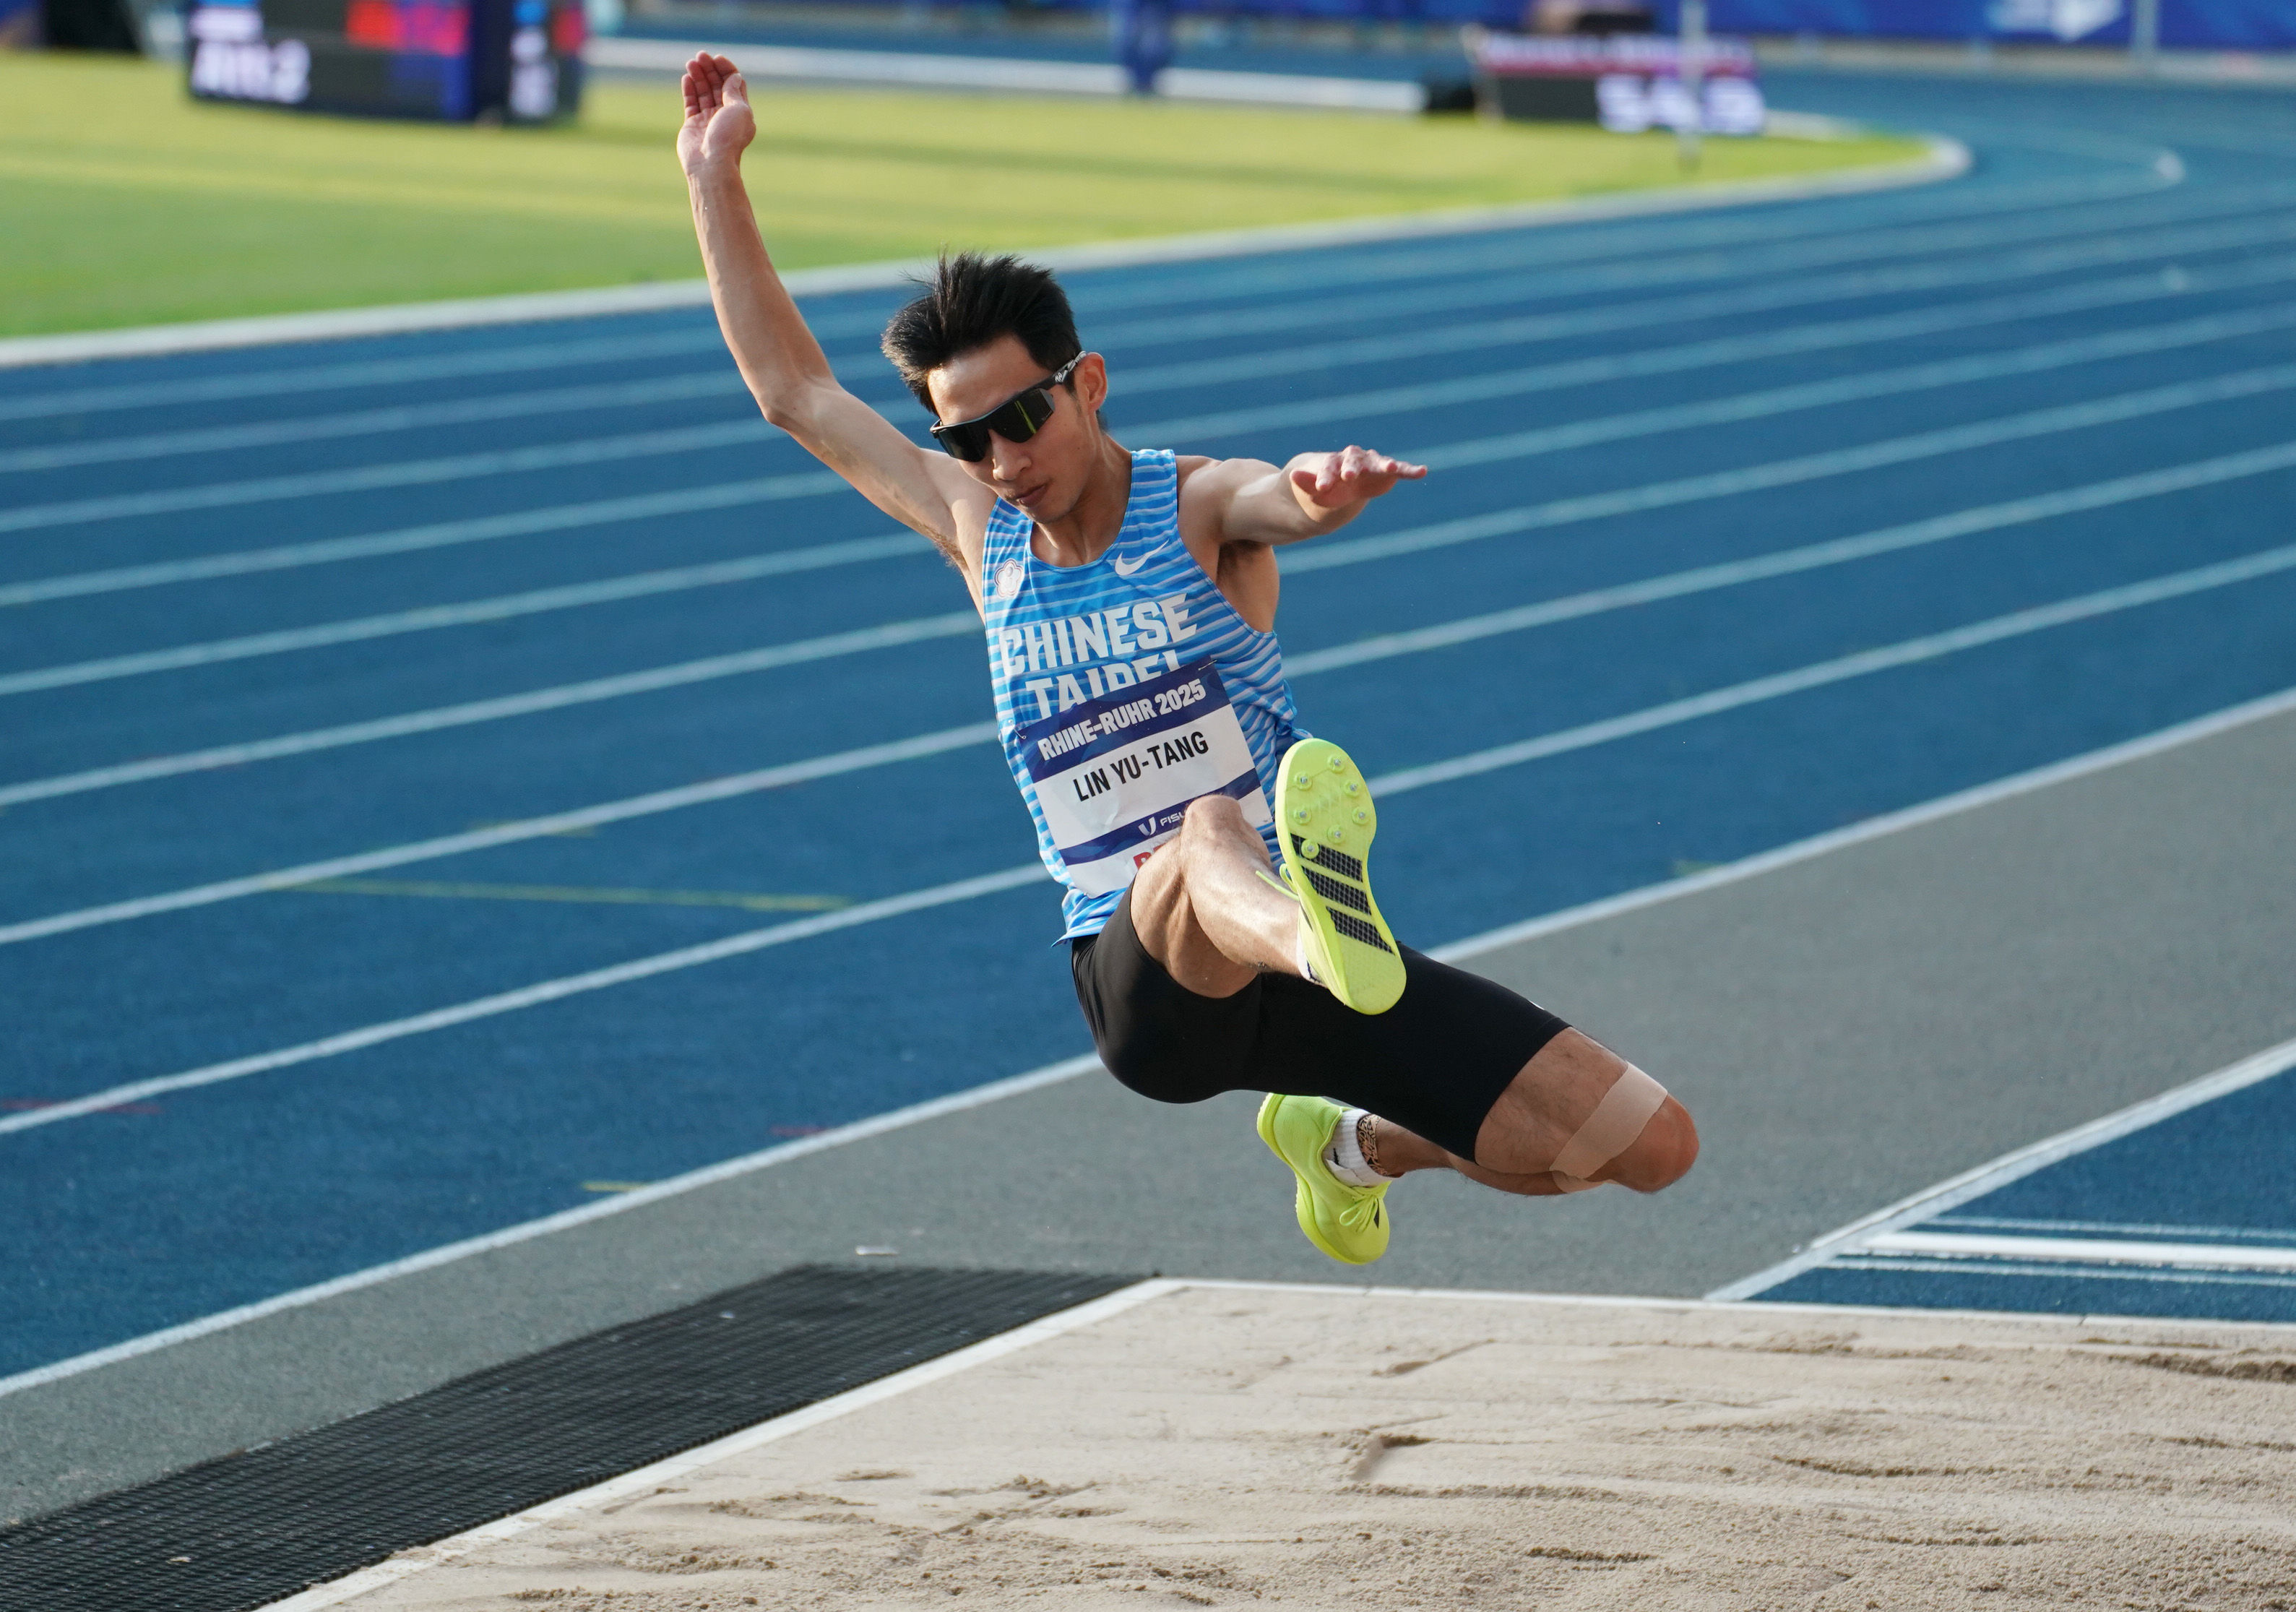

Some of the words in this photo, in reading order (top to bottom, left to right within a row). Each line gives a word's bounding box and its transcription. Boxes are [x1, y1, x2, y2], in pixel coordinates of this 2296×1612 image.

[998, 592, 1197, 676] CHINESE
[1037, 699, 1157, 762] RHINE-RUHR
[1155, 678, 1207, 715] 2025
[1073, 767, 1111, 802] LIN
[1110, 731, 1209, 785] YU-TANG
